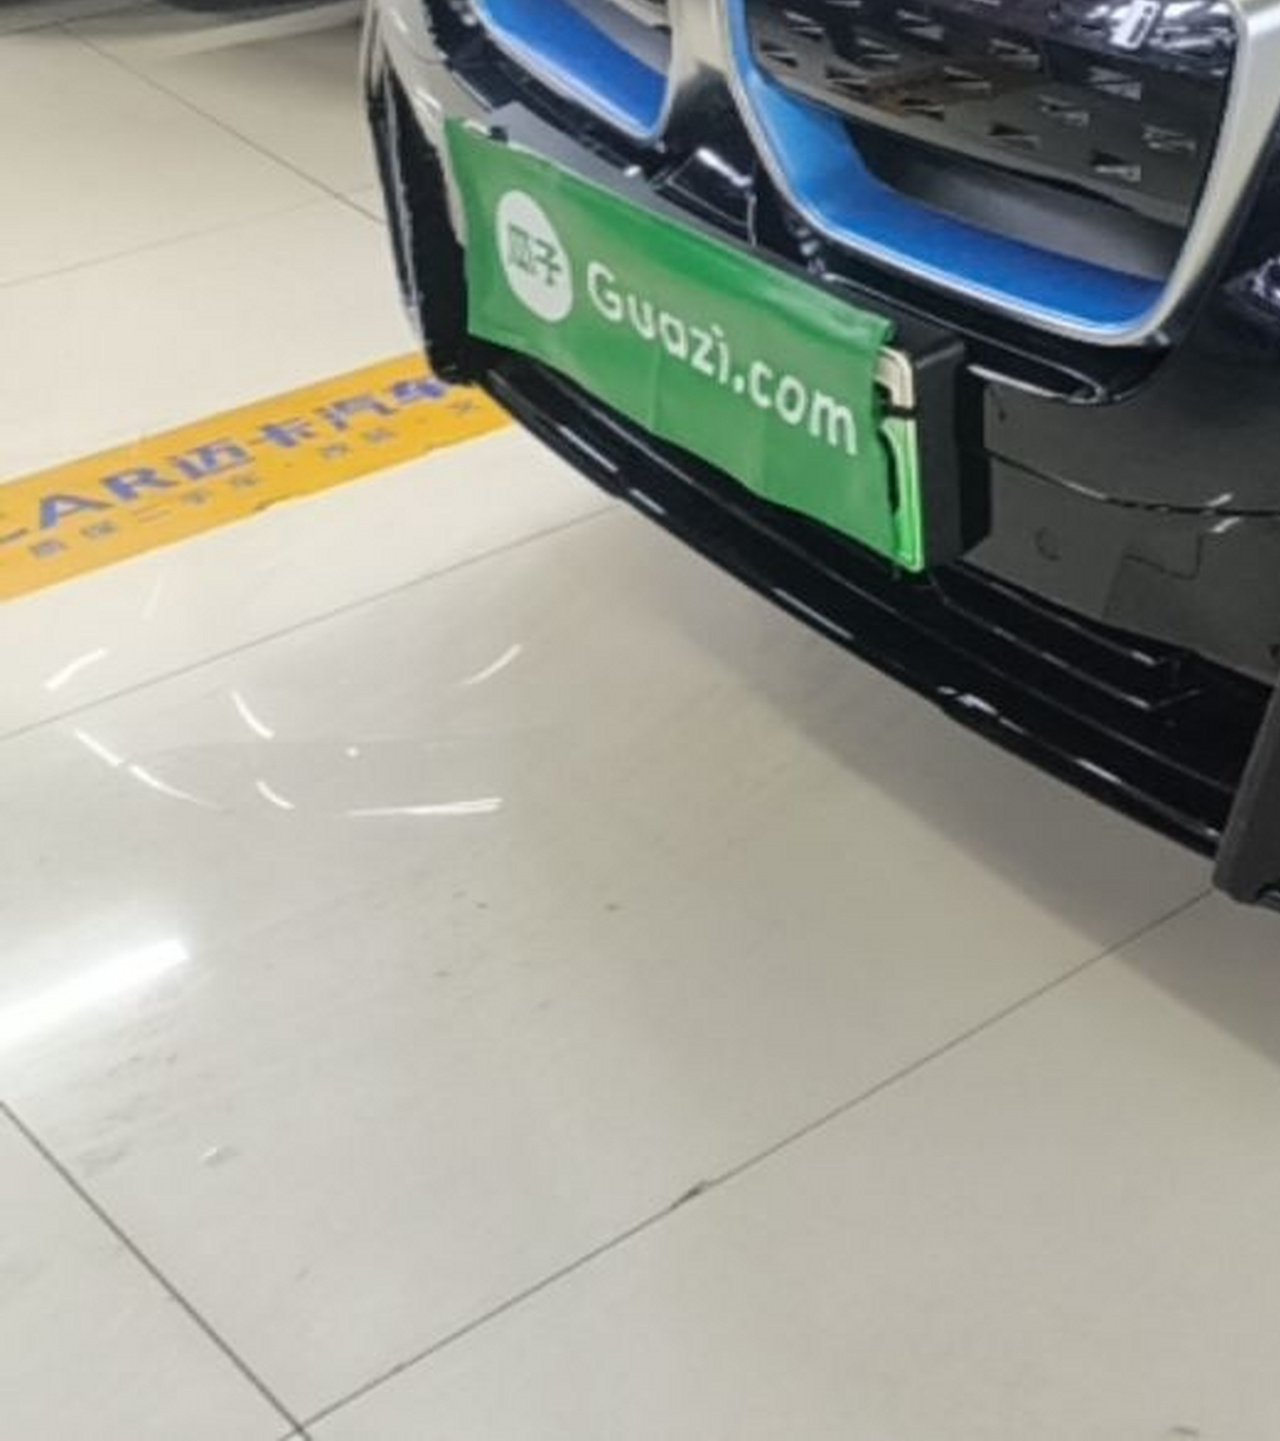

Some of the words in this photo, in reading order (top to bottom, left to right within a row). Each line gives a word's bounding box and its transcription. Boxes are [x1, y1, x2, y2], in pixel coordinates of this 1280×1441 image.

[507, 221, 563, 287] 瓜子
[586, 260, 858, 457] Guazi.com
[0, 376, 452, 546] AR迈卡汽车
